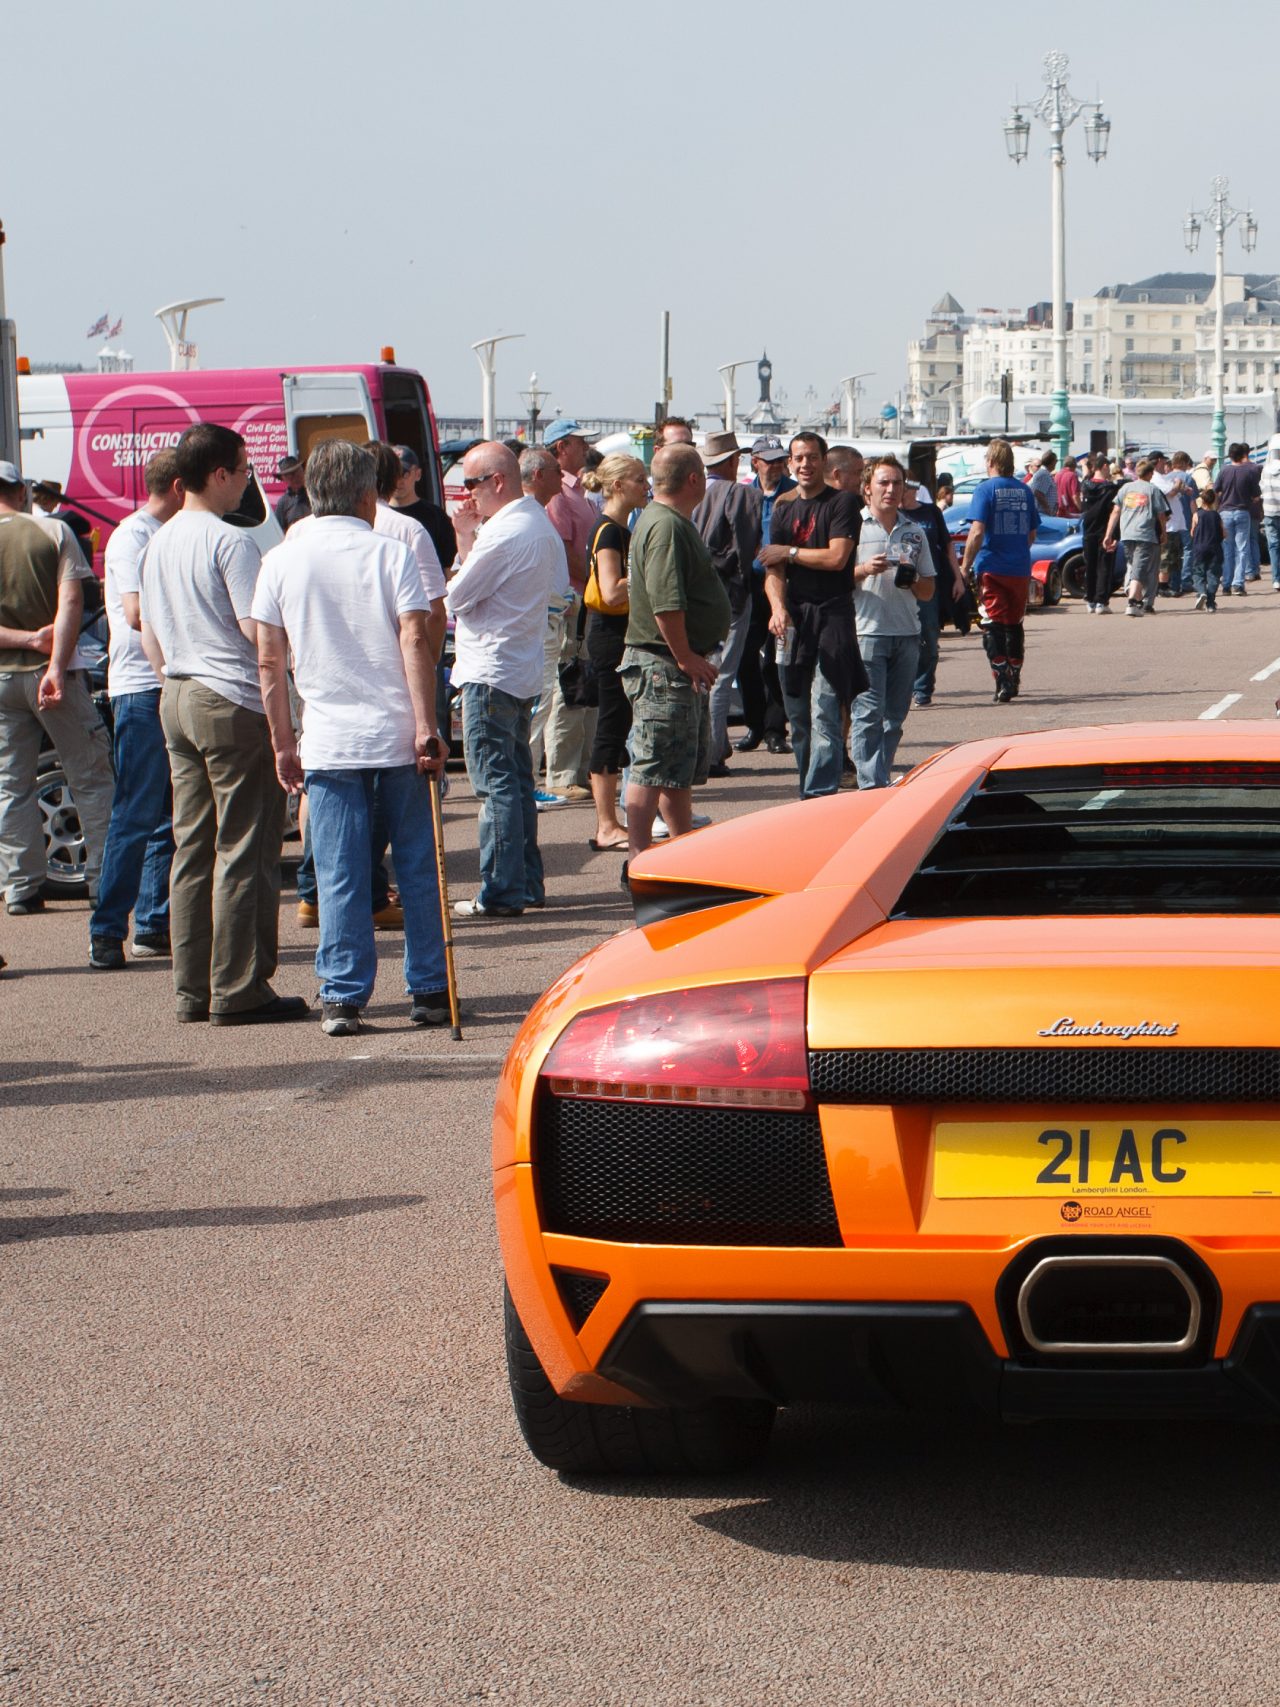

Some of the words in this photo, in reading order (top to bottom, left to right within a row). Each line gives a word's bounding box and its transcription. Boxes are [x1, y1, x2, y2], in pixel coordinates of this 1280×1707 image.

[91, 432, 182, 451] CONSTRUCTIO
[112, 449, 160, 468] SERVIC
[1037, 1017, 1179, 1041] Lamborghini
[1036, 1129, 1090, 1183] 21
[1109, 1129, 1187, 1183] AC
[1084, 1206, 1114, 1216] ROAD
[1116, 1206, 1152, 1217] ANGEL
